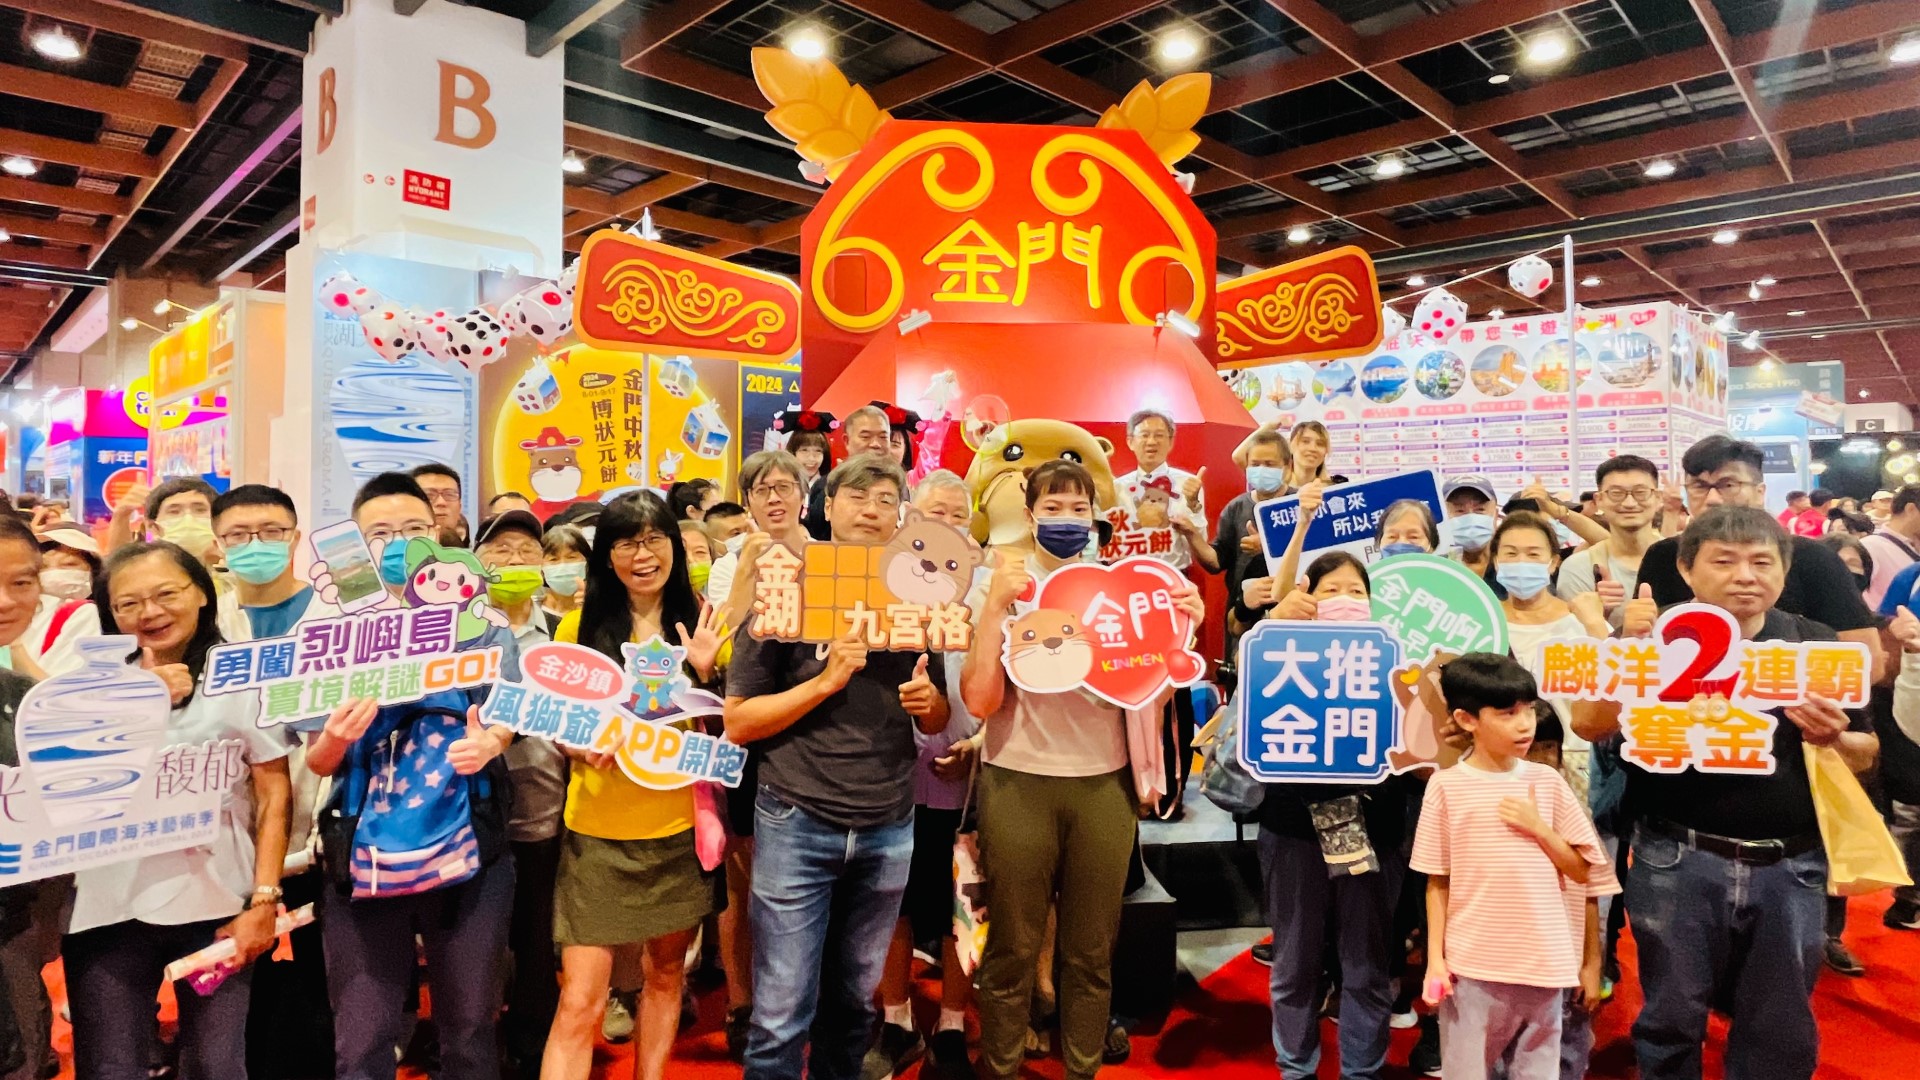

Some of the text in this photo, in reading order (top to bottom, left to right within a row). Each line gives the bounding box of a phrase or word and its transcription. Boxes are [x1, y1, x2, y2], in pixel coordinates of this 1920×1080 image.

[317, 67, 337, 154] B
[434, 59, 497, 149] B
[922, 218, 1103, 309] 金門
[746, 373, 783, 394] 2024
[592, 398, 618, 484] 博狀元餅
[752, 543, 802, 638] 金湖
[1081, 588, 1179, 648] 金門
[843, 599, 973, 650] 九宮格
[535, 654, 615, 695] 金沙鎮
[1102, 652, 1164, 672] KINMEN
[1262, 638, 1381, 700] 大推
[1261, 703, 1378, 767] 金門
[1628, 704, 1770, 770] 奪金
[155, 744, 243, 800] 馥郁
[31, 809, 215, 860] 金門國際海洋藝術季
